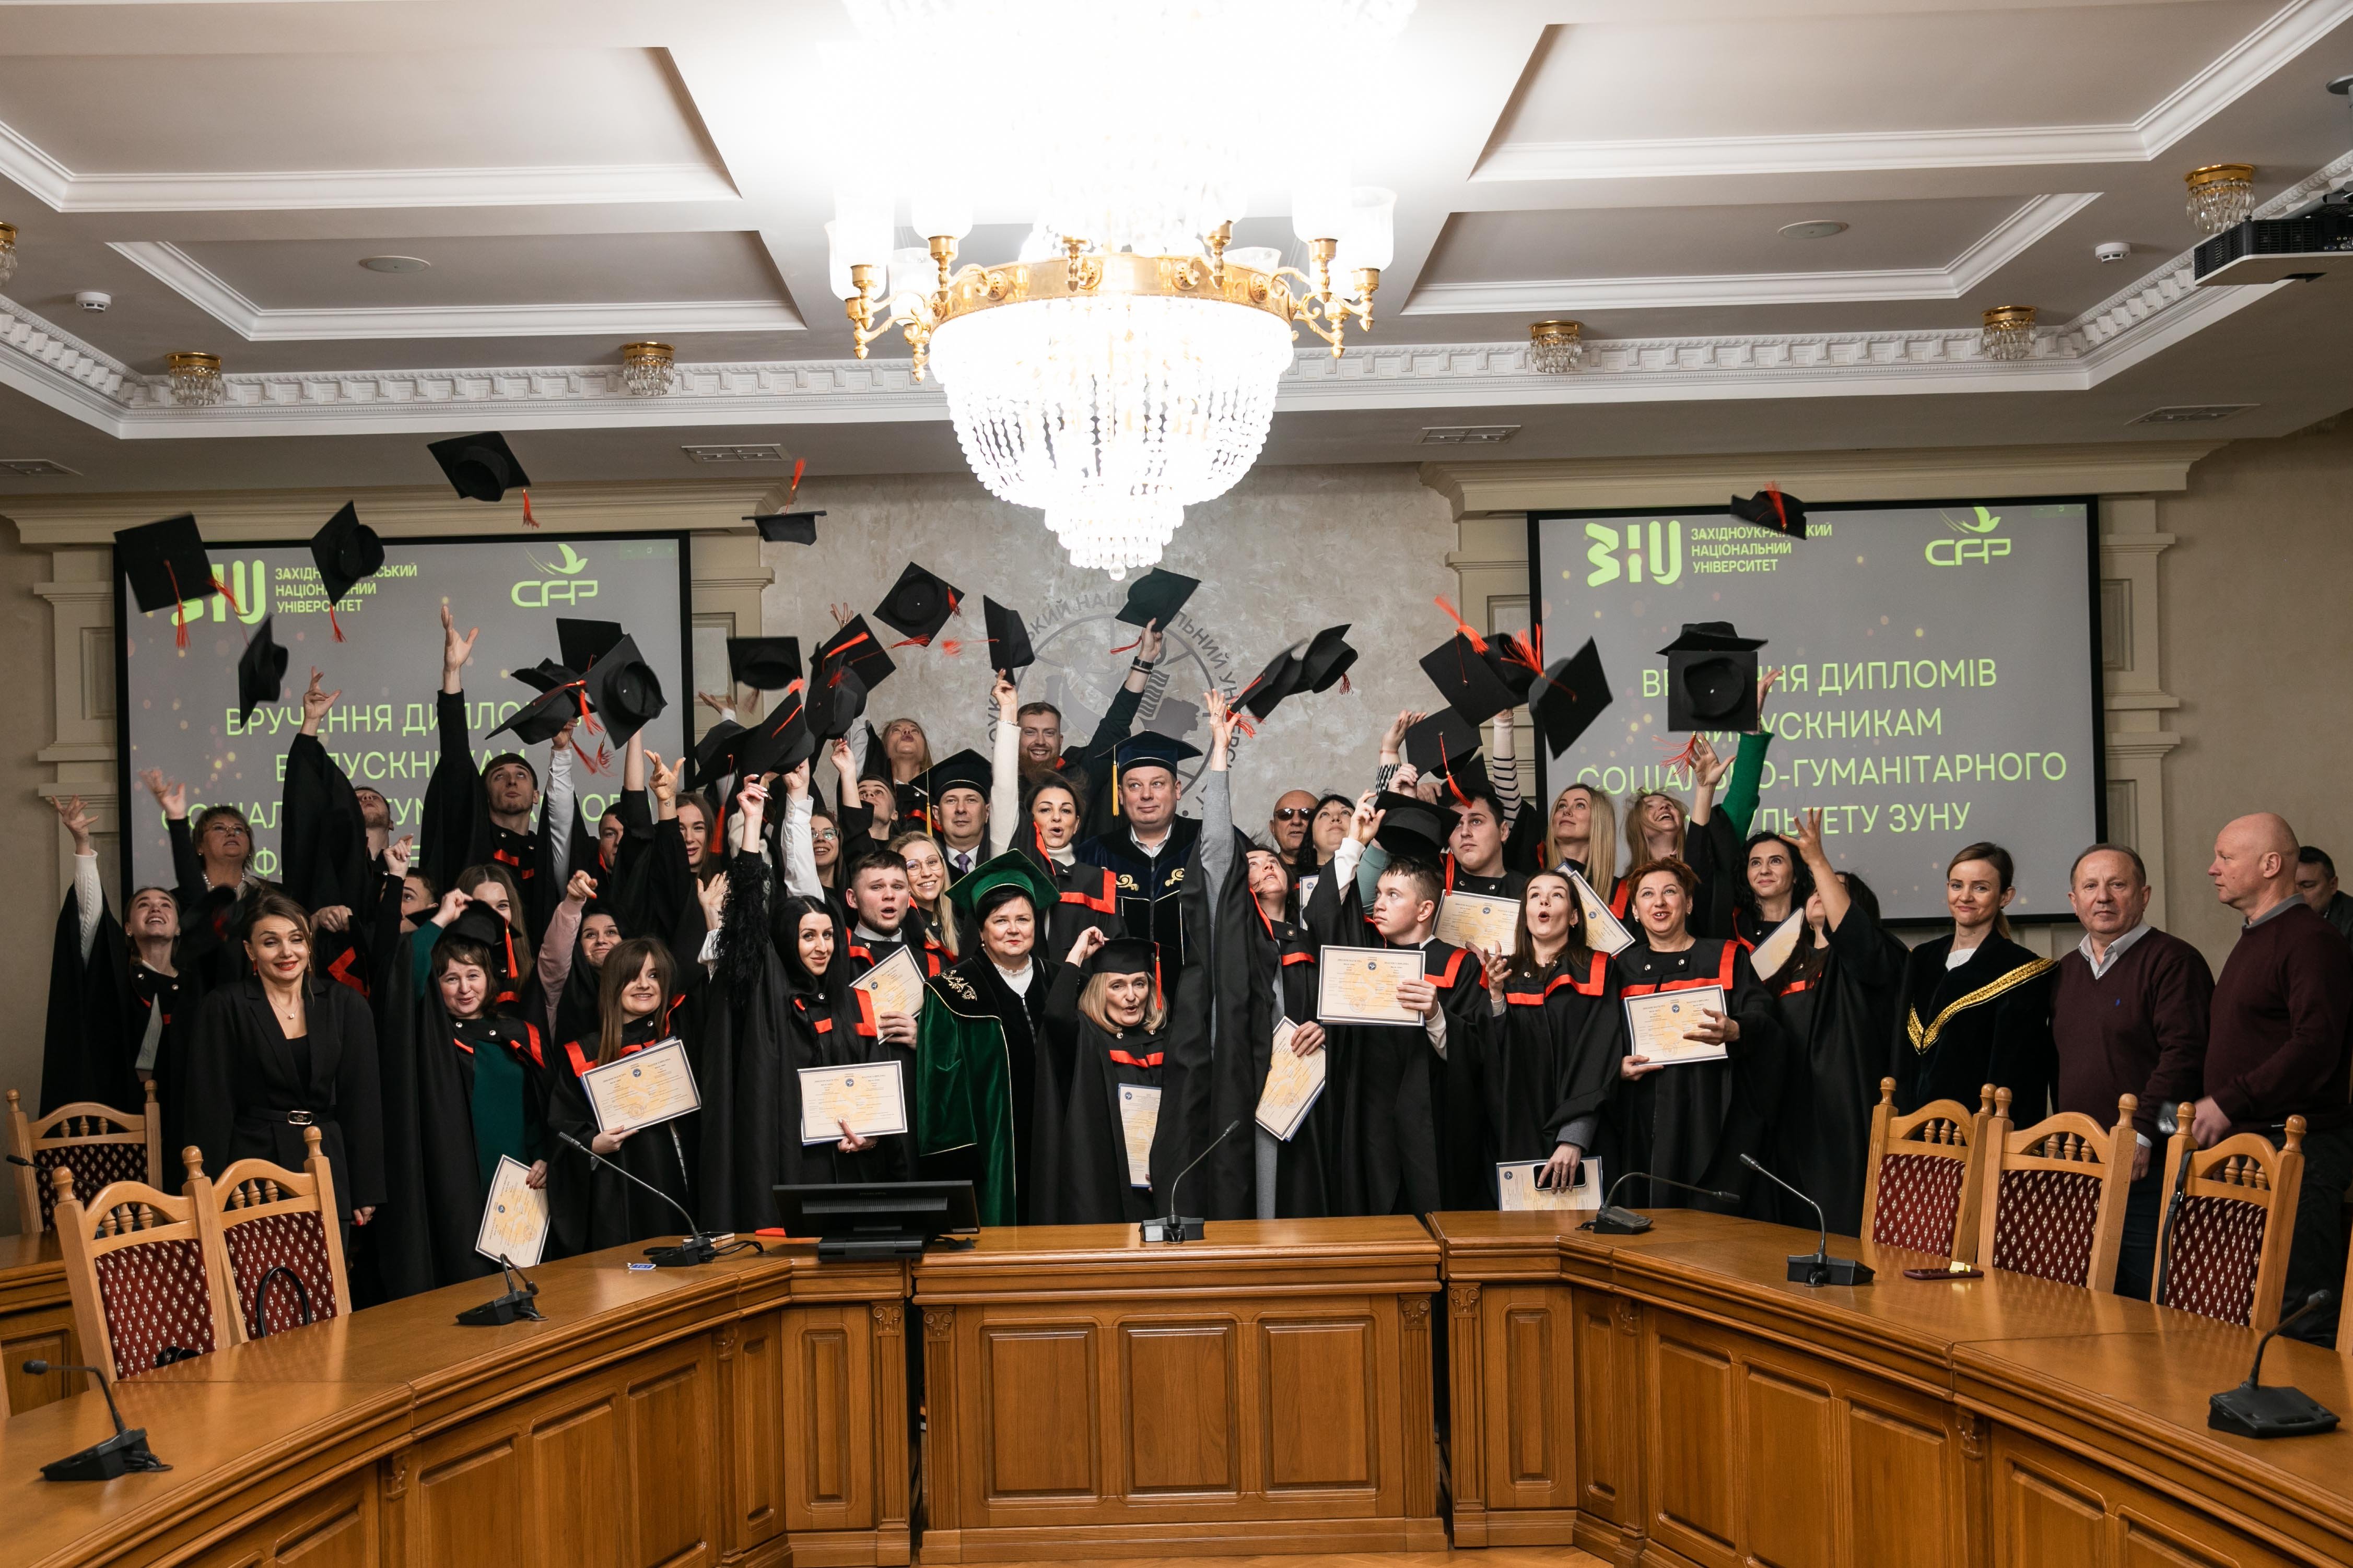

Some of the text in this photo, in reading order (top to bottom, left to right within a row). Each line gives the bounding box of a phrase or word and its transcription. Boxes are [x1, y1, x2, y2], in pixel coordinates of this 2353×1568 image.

[1691, 522, 1832, 541] ЗАХІДНОУКРАКИЙ
[1691, 540, 1792, 558] НАЦІОНАЛЬНИЙ
[1693, 559, 1778, 573] УНІВЕРСИТЕТ
[275, 581, 377, 598] НАЦІОННИЙ
[1818, 658, 1997, 697] ДИПЛОМІВ
[226, 704, 392, 736] ВРУЧННЯ
[1889, 801, 1971, 832] ЗУНУ
